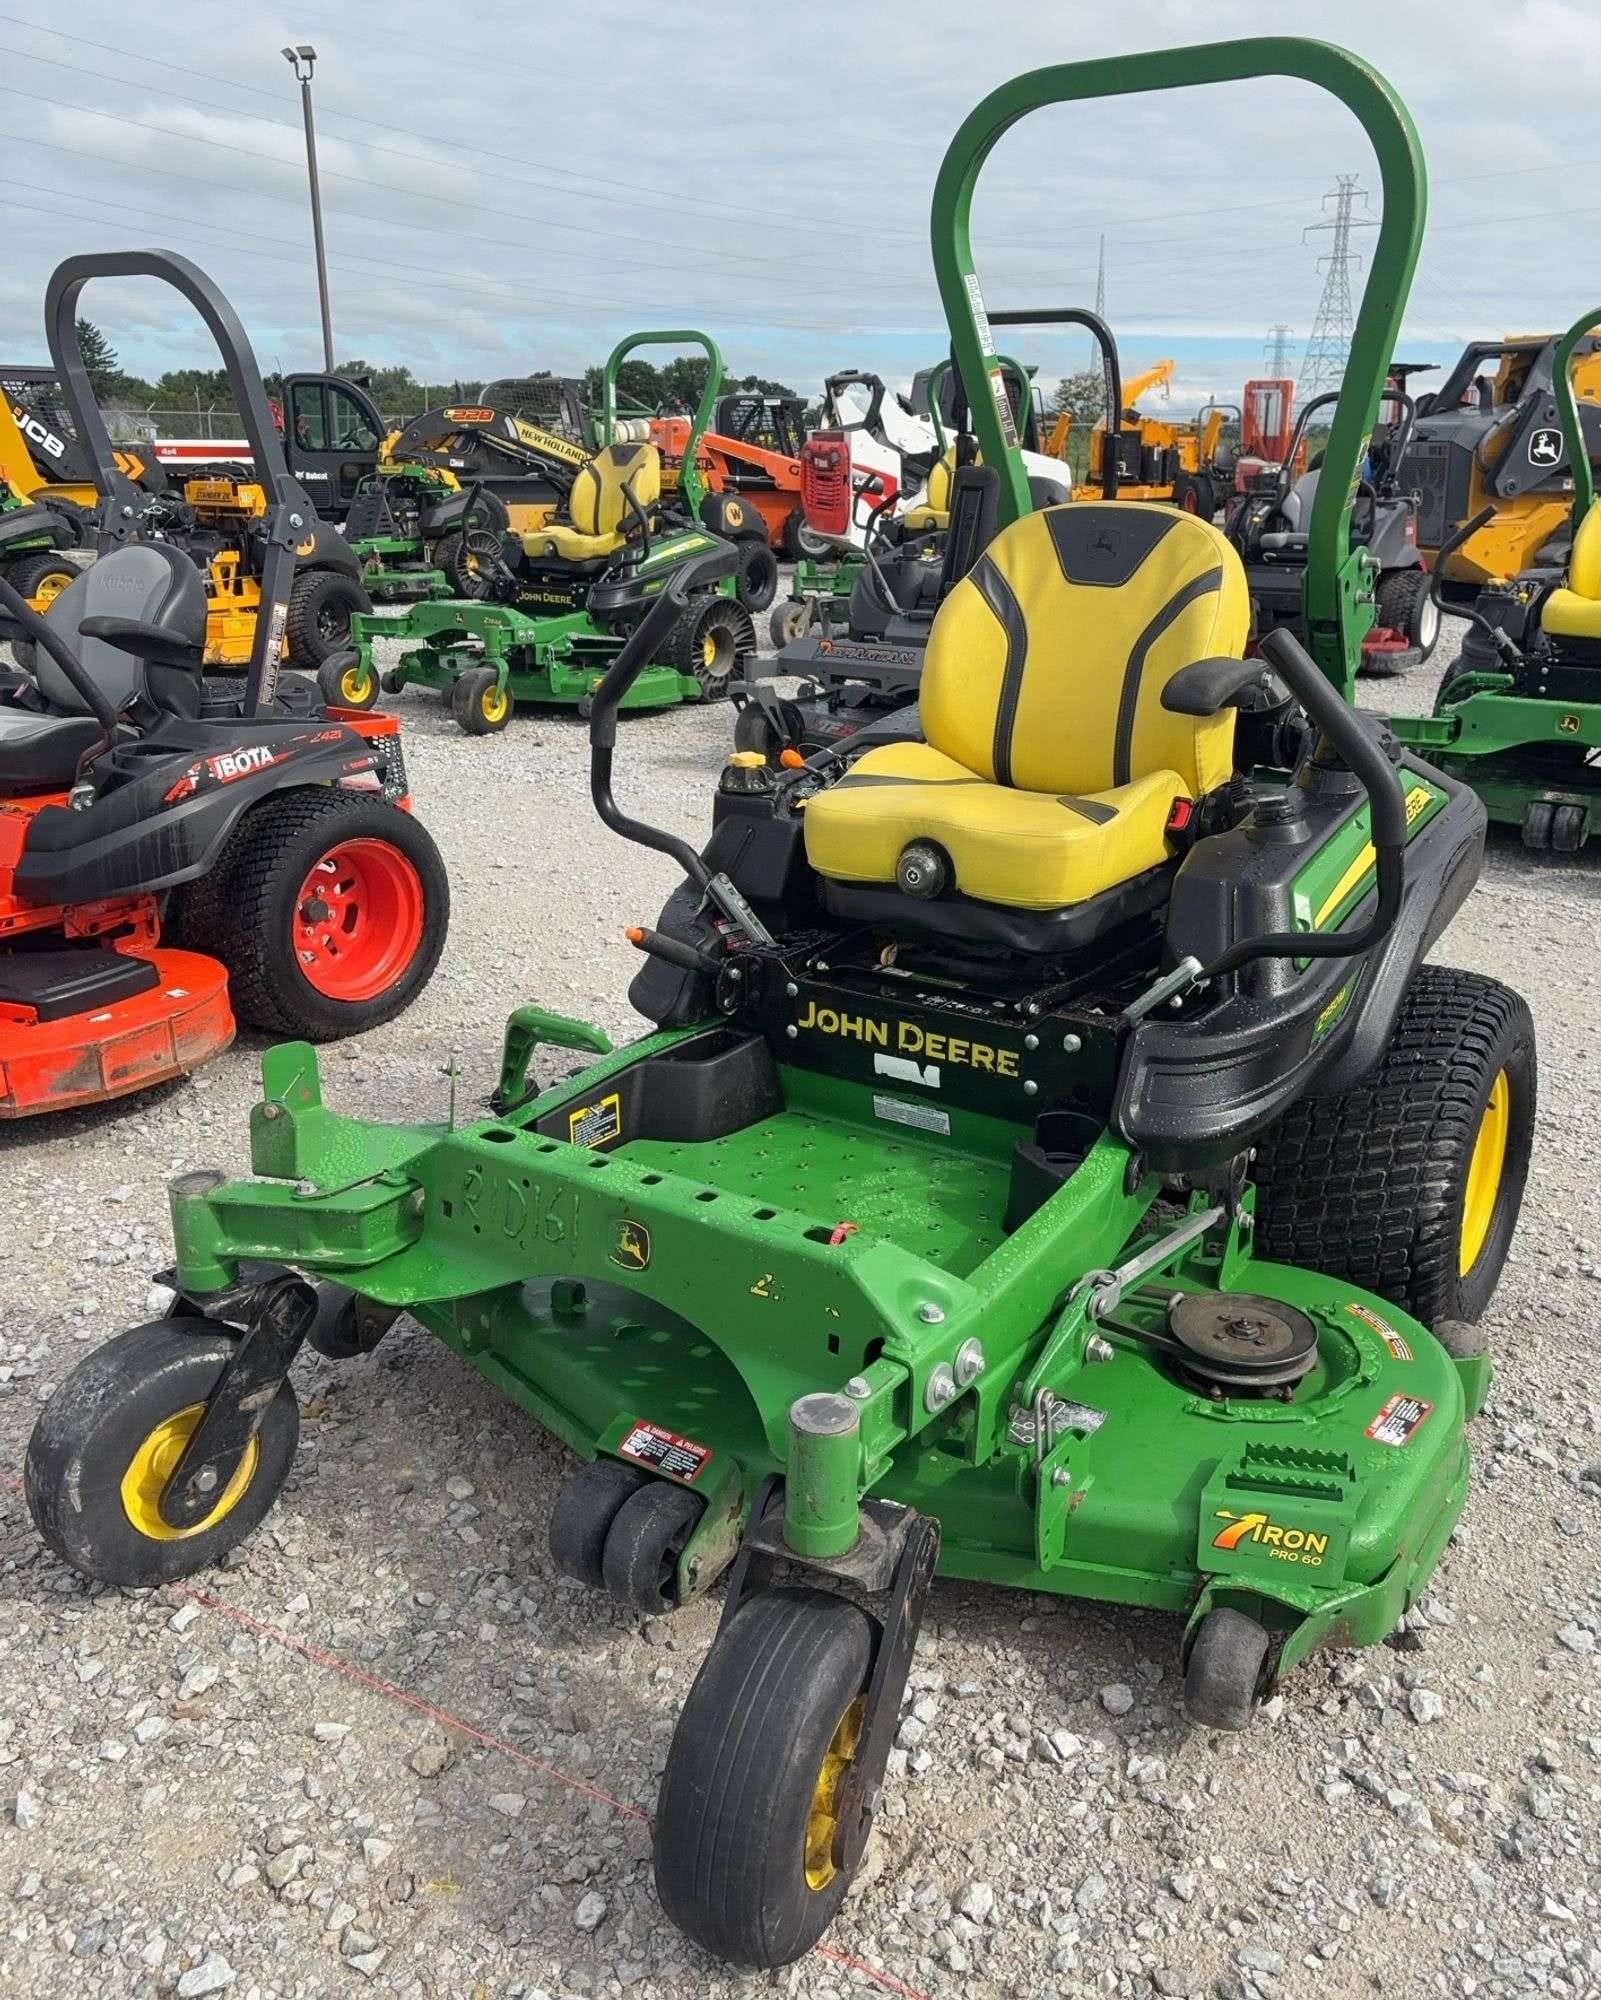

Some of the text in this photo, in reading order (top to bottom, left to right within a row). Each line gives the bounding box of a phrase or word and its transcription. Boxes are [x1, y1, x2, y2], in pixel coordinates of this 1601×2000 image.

[11, 412, 65, 458] JCB
[520, 428, 587, 461] NEW HOLLAND
[305, 471, 328, 481] Bobcat
[518, 591, 573, 606] JOHN DEERE
[797, 1001, 889, 1046] JOHN
[898, 1020, 1020, 1078] DEERE
[1251, 1523, 1329, 1555] IRON
[1268, 1549, 1323, 1567] PRO 60
